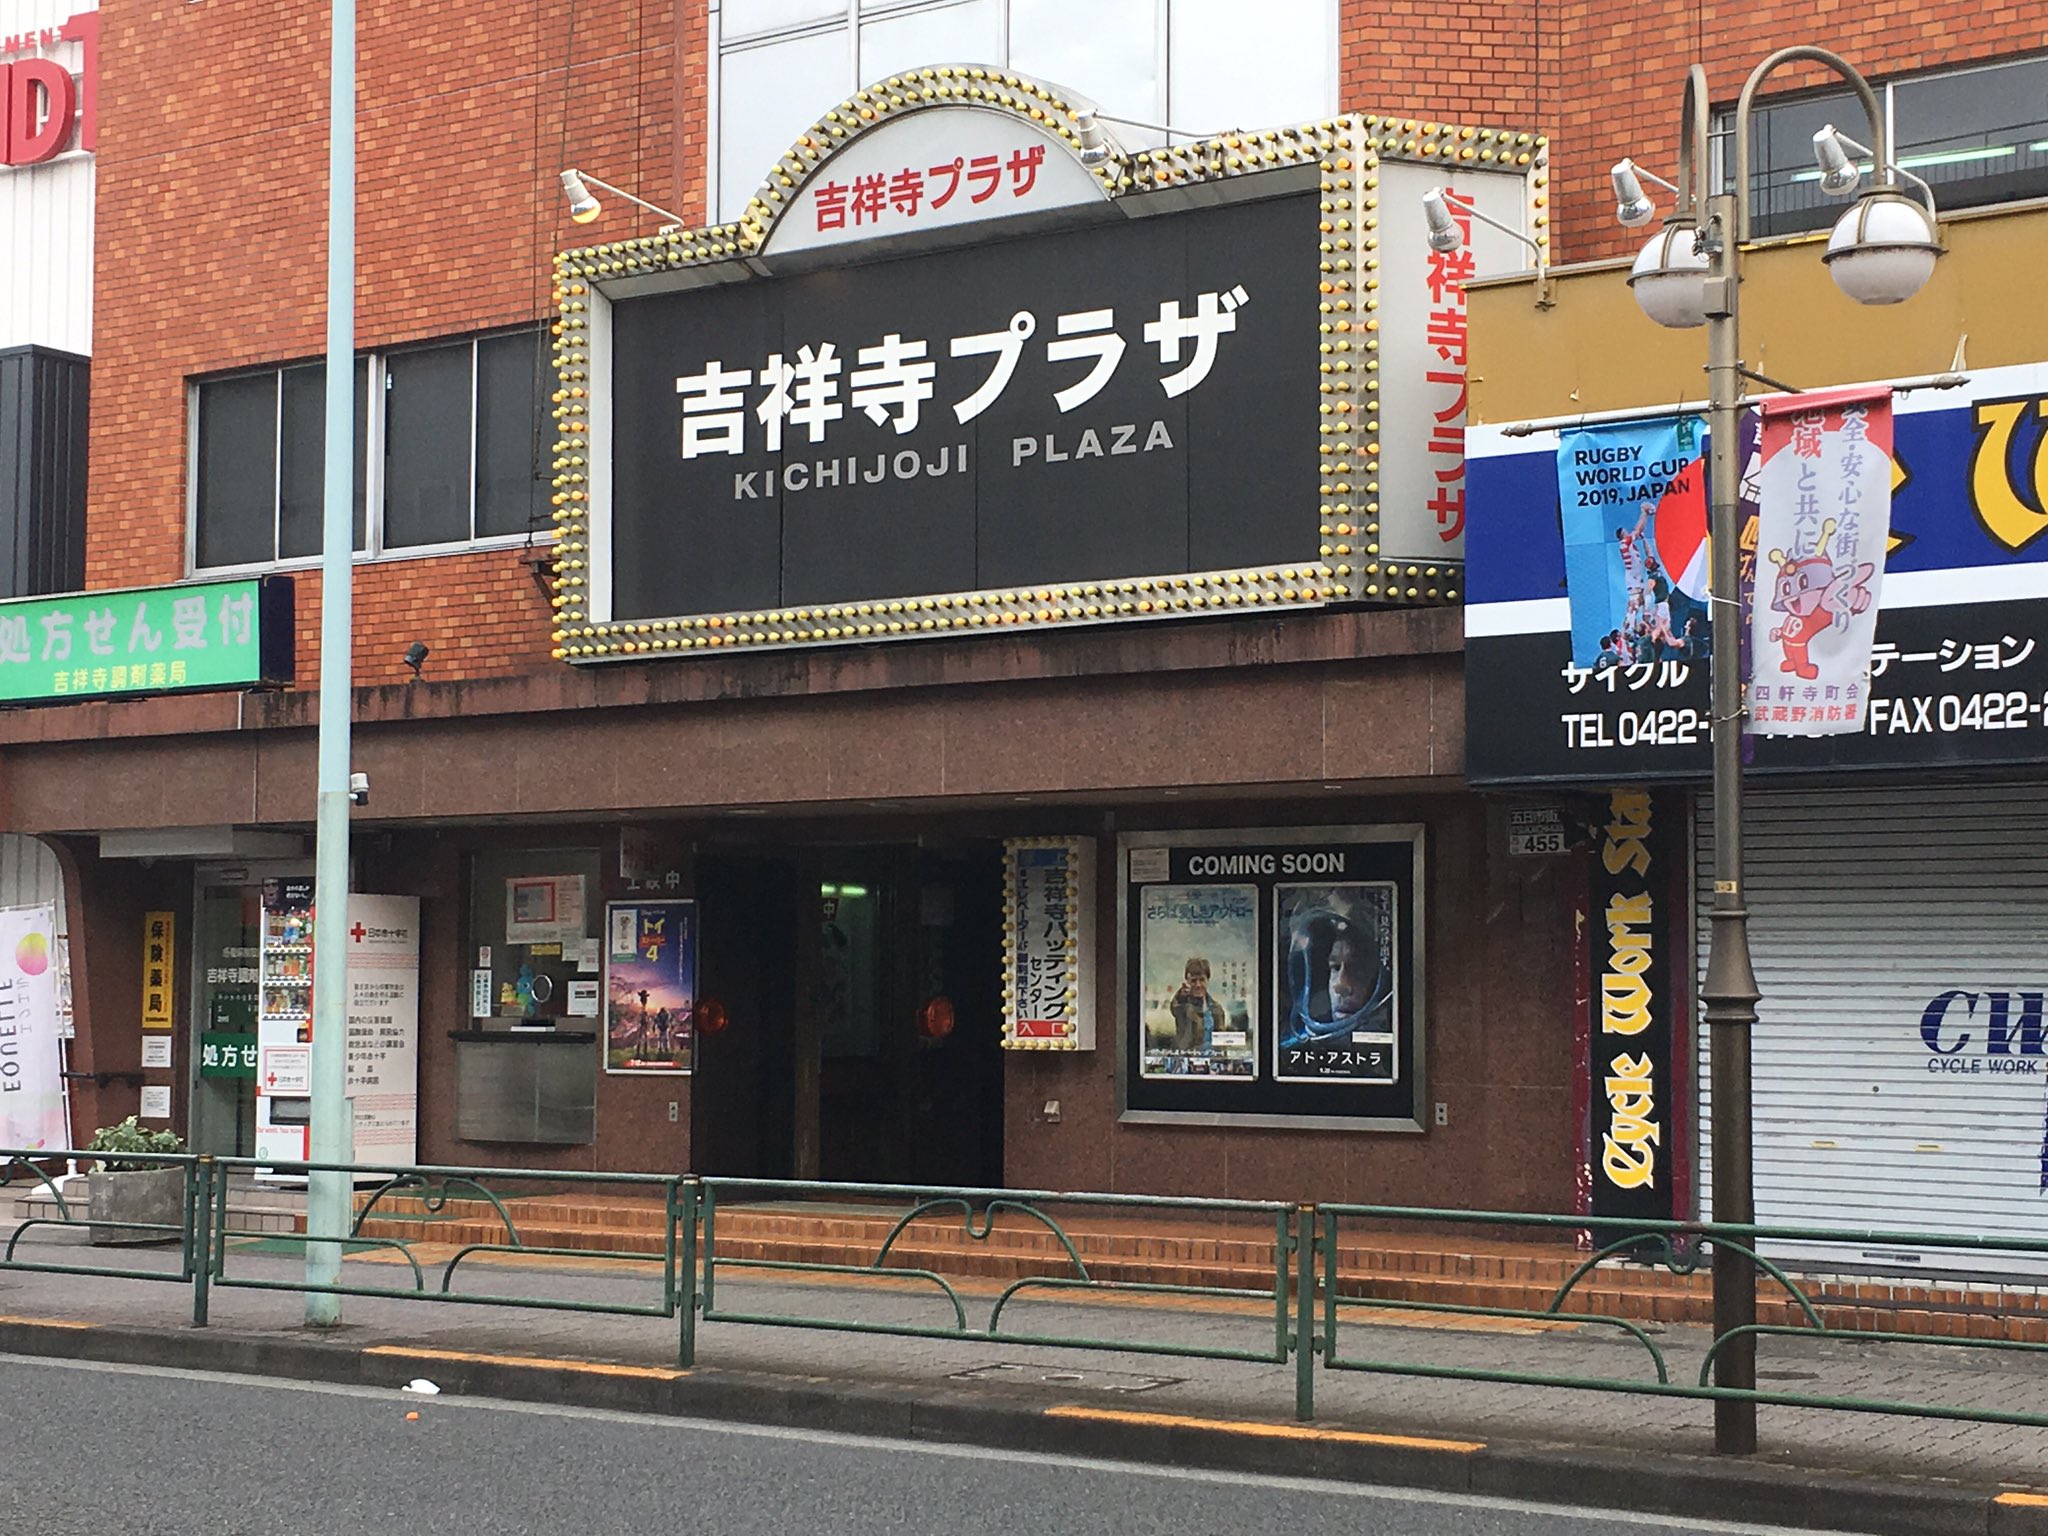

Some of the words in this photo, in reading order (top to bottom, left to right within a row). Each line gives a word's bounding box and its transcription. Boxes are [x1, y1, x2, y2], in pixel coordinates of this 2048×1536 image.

[0, 11, 98, 166] D1
[814, 144, 1046, 232] 吉祥寺プラザ
[676, 284, 1250, 459] 吉祥寺プラザ
[734, 444, 968, 500] KICHIJOJI
[1013, 420, 1174, 466] PLAZA
[1575, 445, 1643, 466] RUGBY
[1576, 466, 1646, 487] WORLD
[1649, 457, 1690, 478] CUP
[1577, 488, 1625, 507] 2019,
[1626, 478, 1690, 502] JAPAN
[54, 660, 187, 692] 吉祥寺調剤薬局
[1561, 660, 1690, 694] サイクル
[1755, 683, 1859, 701] 四軒寺町会
[1754, 703, 1857, 722] 武蔵野消防署
[1870, 696, 1933, 735] FAX
[1939, 691, 2048, 732] 0422-
[1561, 713, 1614, 748] TEL
[1618, 709, 1714, 746] 0422-
[1525, 835, 1559, 852] 455
[1188, 854, 1276, 876] COMING
[1281, 853, 1345, 874] SOON
[149, 920, 165, 1013] 保険薬局
[646, 944, 658, 962] 4
[1602, 890, 1653, 1036] Work
[1029, 956, 1042, 1019] センター
[1019, 1022, 1066, 1035] 入口
[202, 1044, 257, 1067] 処方せ
[1290, 1050, 1381, 1066] アド・アストラ
[1927, 1058, 1981, 1074] CYCLE
[1988, 1059, 2038, 1074] WORK
[1602, 1050, 1660, 1189] Cycle
